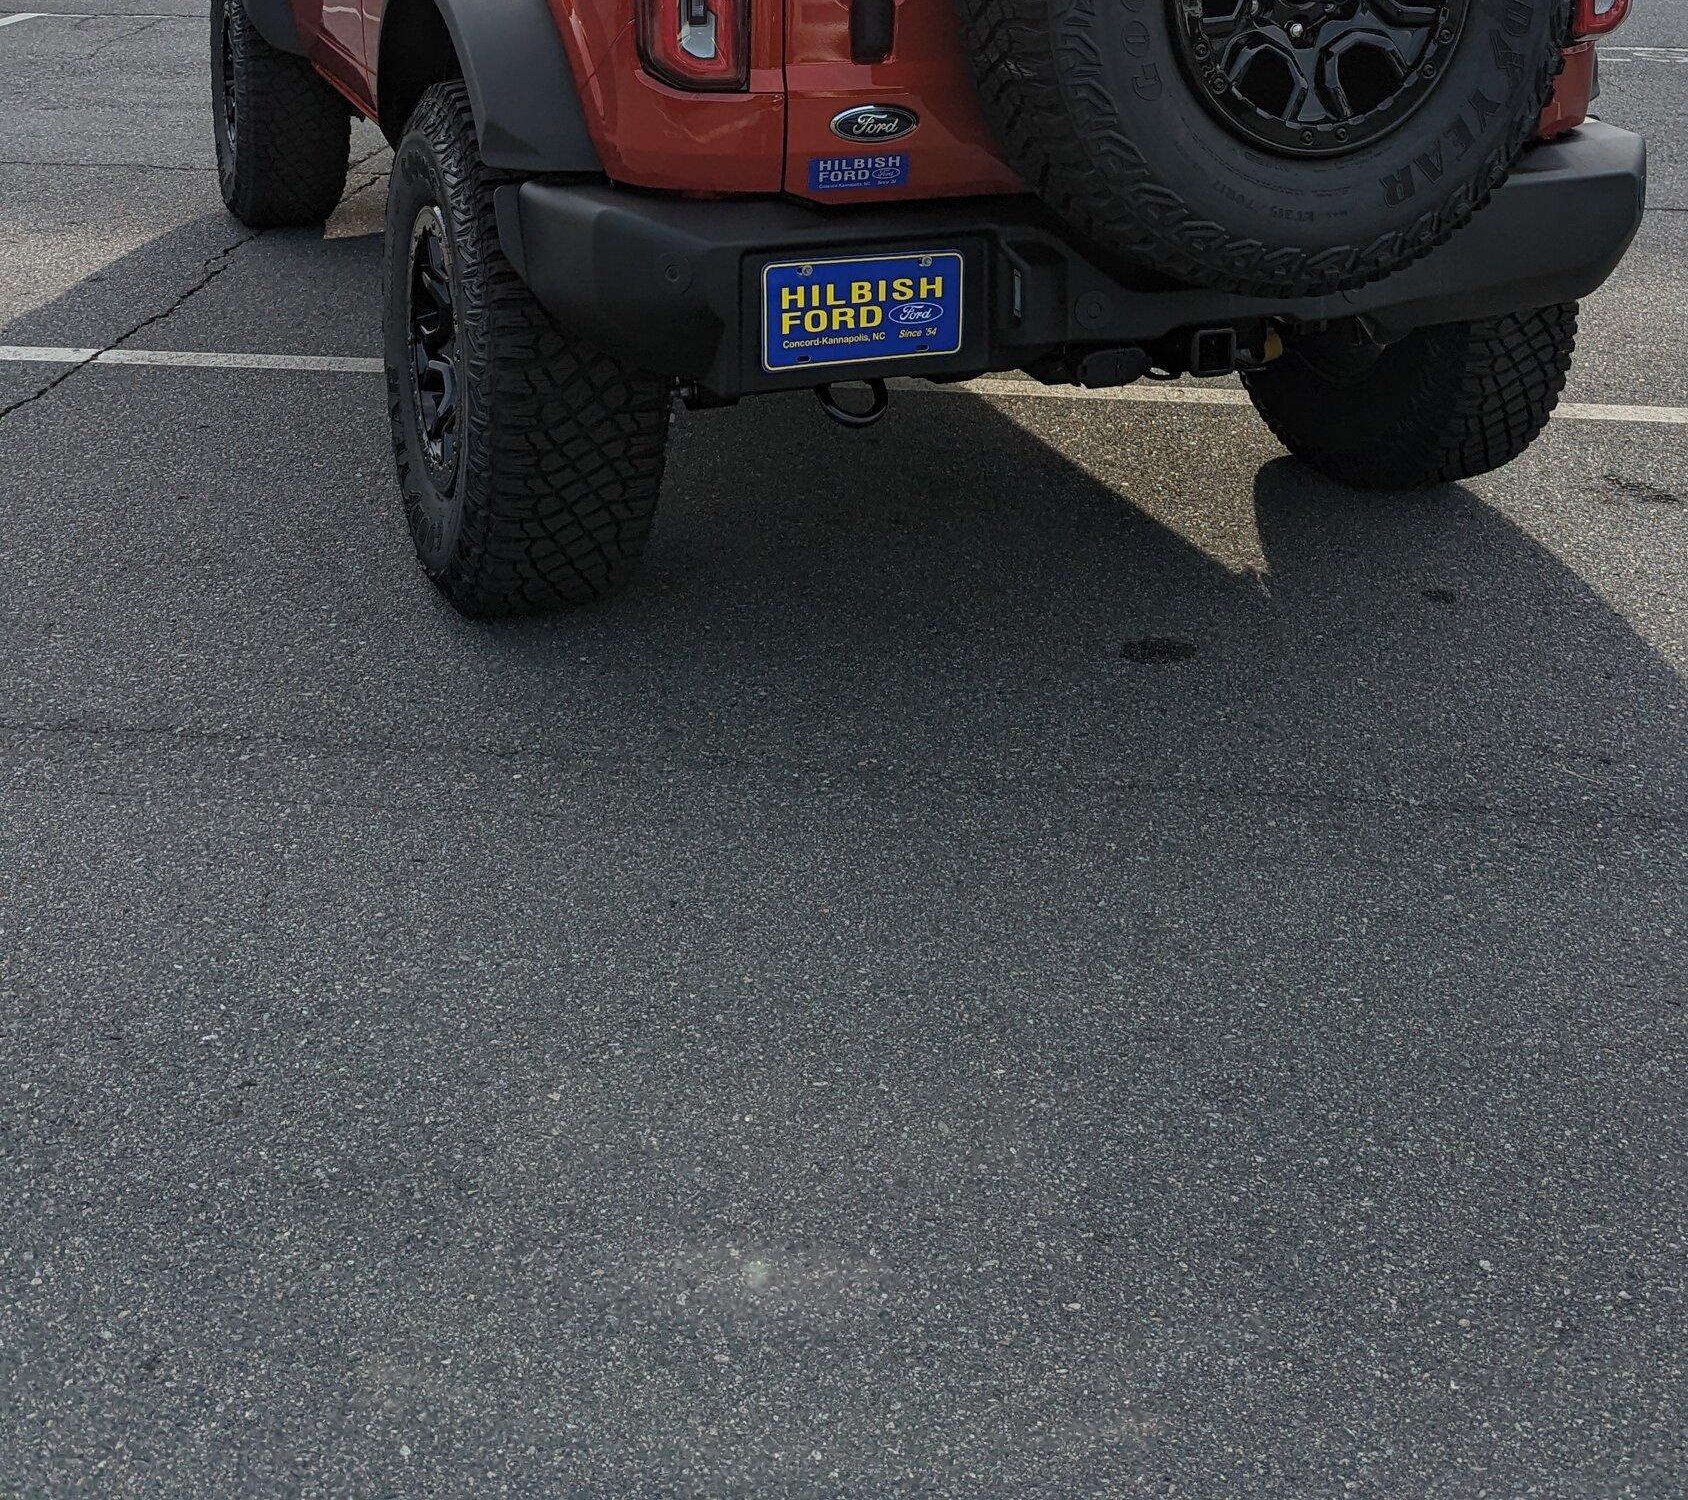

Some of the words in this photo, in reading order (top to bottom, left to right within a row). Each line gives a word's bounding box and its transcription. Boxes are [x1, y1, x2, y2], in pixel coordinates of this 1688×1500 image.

[853, 113, 899, 135] Ford
[819, 155, 901, 172] HILBISH
[818, 169, 870, 183] FORD
[780, 275, 944, 310] HILBISH
[780, 305, 883, 335] FORD
[899, 303, 932, 321] Ford
[782, 333, 871, 349] Concord-Kannapolis,
[872, 331, 886, 341] NC
[898, 328, 922, 339] Since
[924, 327, 938, 338] '54
